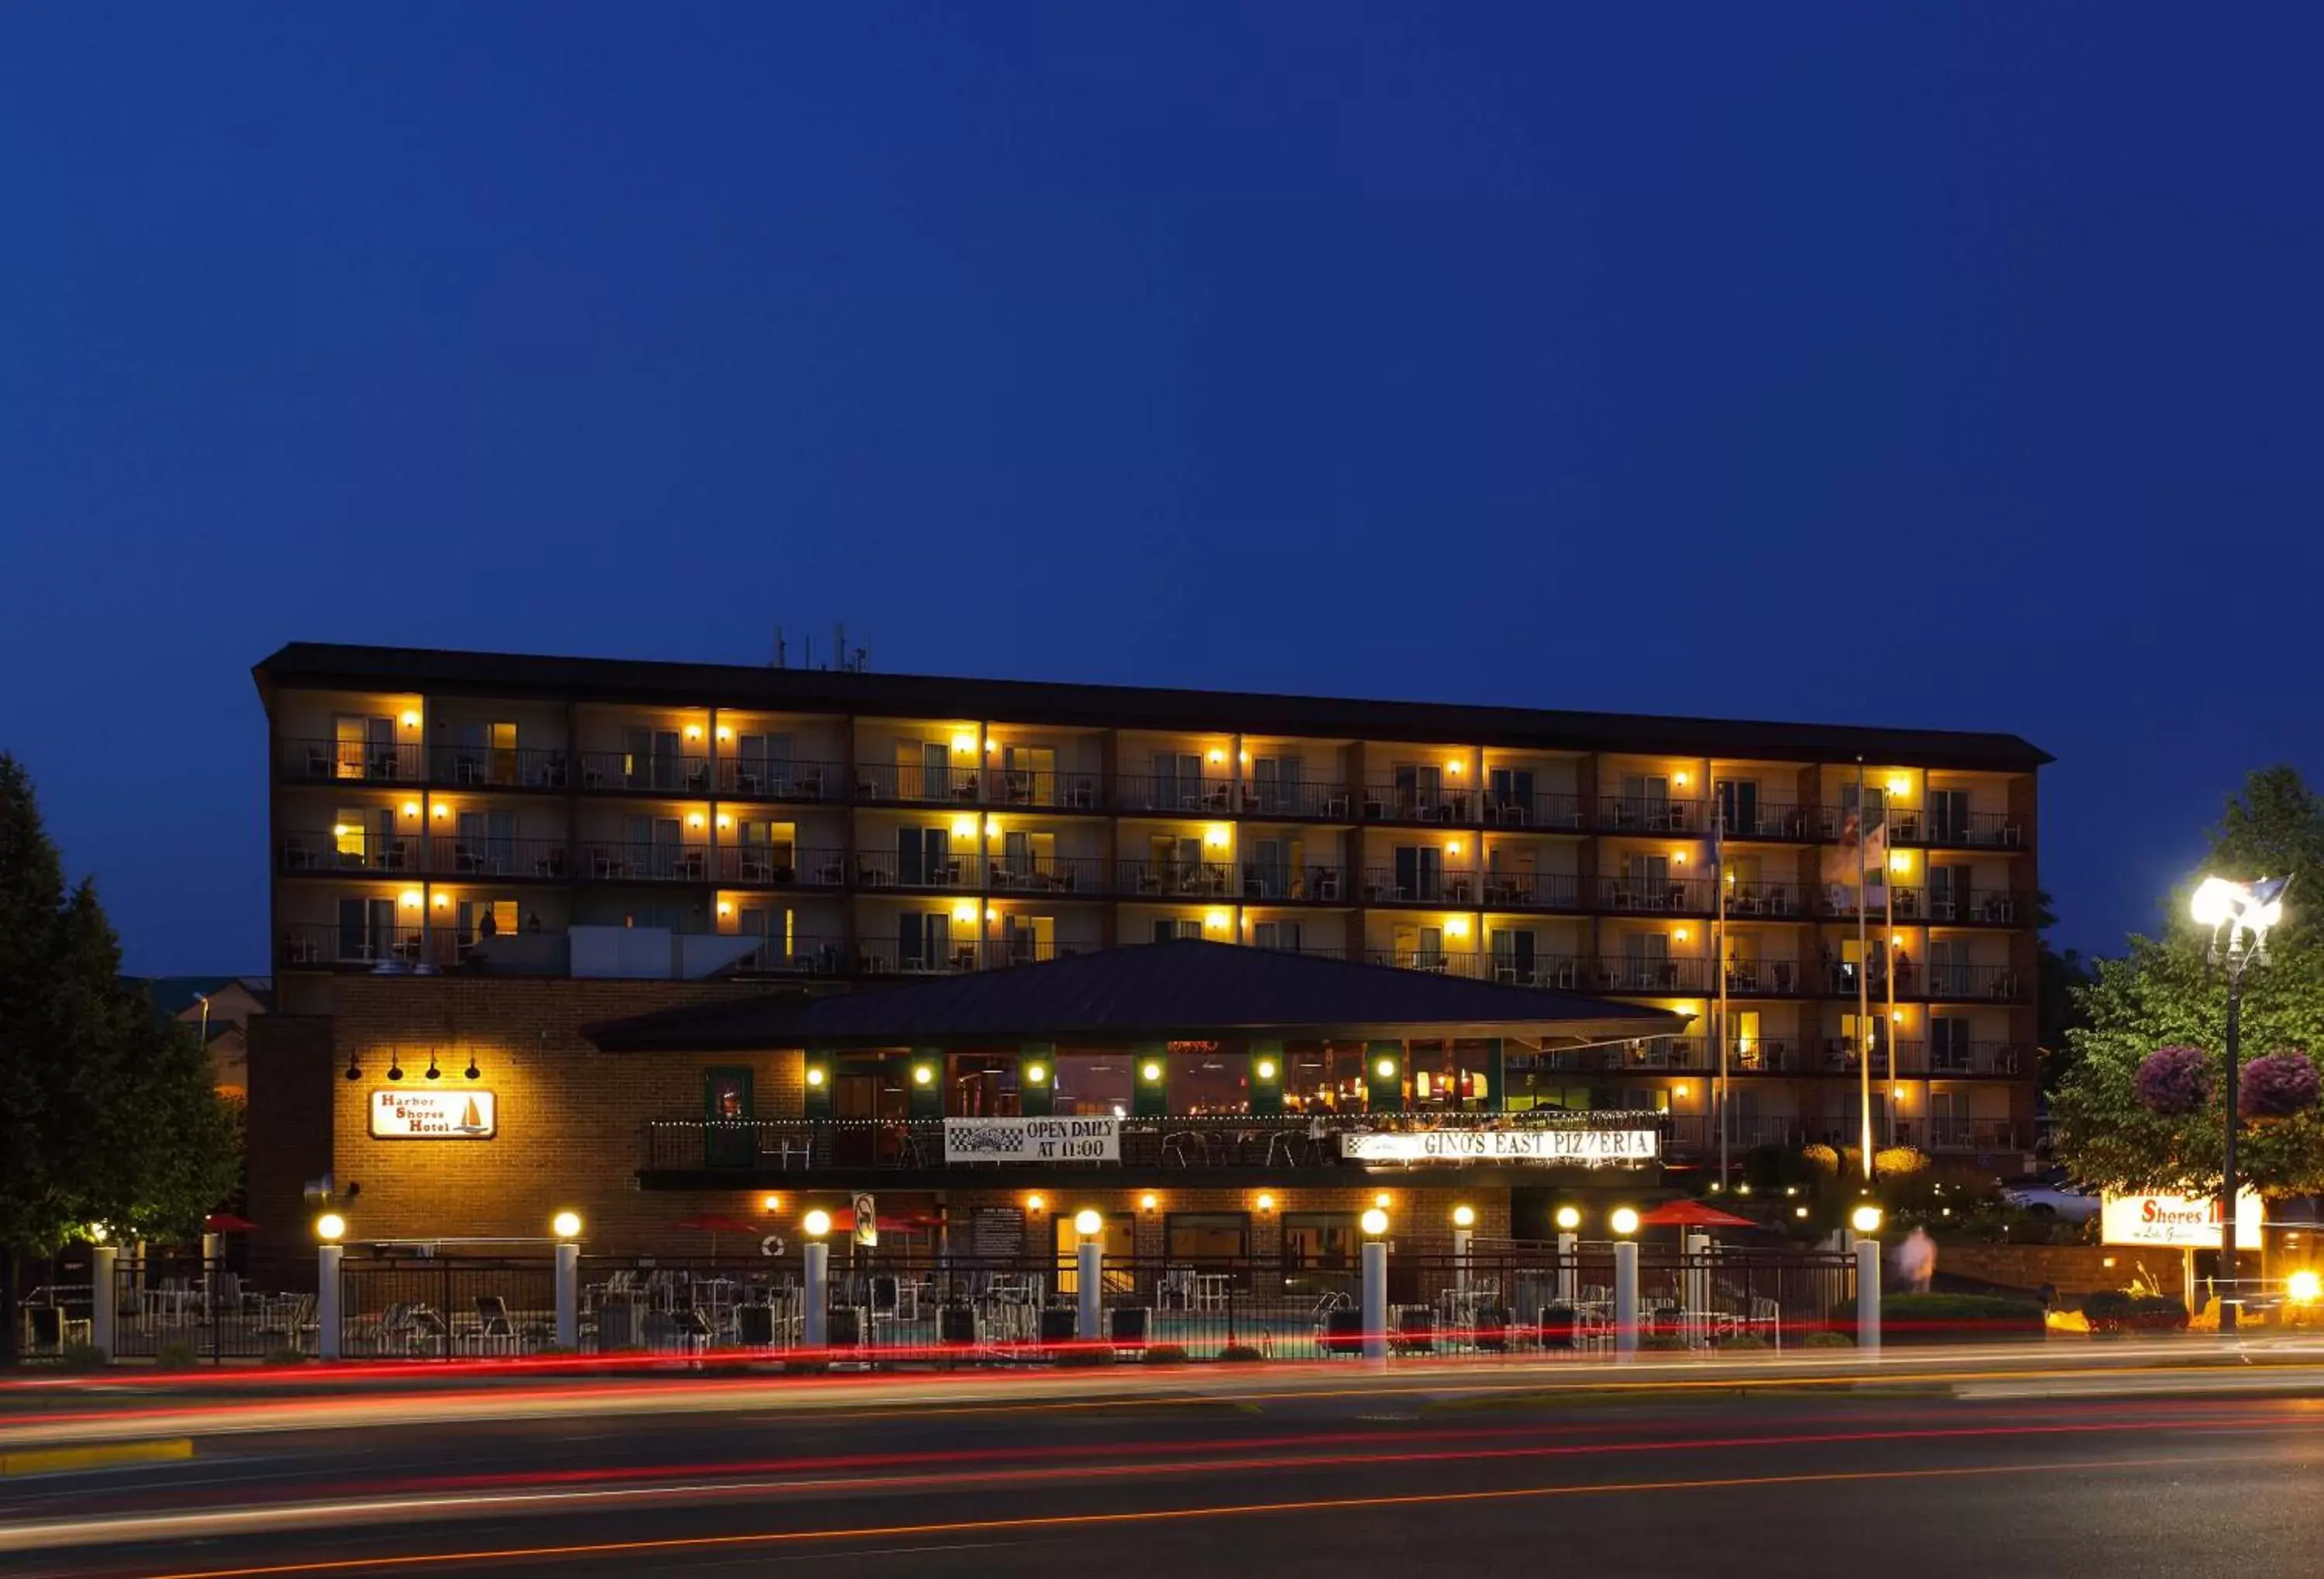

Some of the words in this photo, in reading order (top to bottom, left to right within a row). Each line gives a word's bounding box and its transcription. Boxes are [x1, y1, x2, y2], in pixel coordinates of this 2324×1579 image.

[382, 1094, 434, 1106] Harbor
[397, 1107, 443, 1118] Shores
[410, 1120, 449, 1131] Hotel
[1026, 1121, 1067, 1138] OPEN
[1071, 1120, 1114, 1136] DAILY
[1038, 1141, 1056, 1158] AT
[1062, 1140, 1104, 1157] 11:00
[1424, 1133, 1485, 1154] GINO'S
[1495, 1133, 1544, 1154] EAST
[1555, 1133, 1648, 1154] PIZZERIA
[2141, 1199, 2202, 1224] Shores
